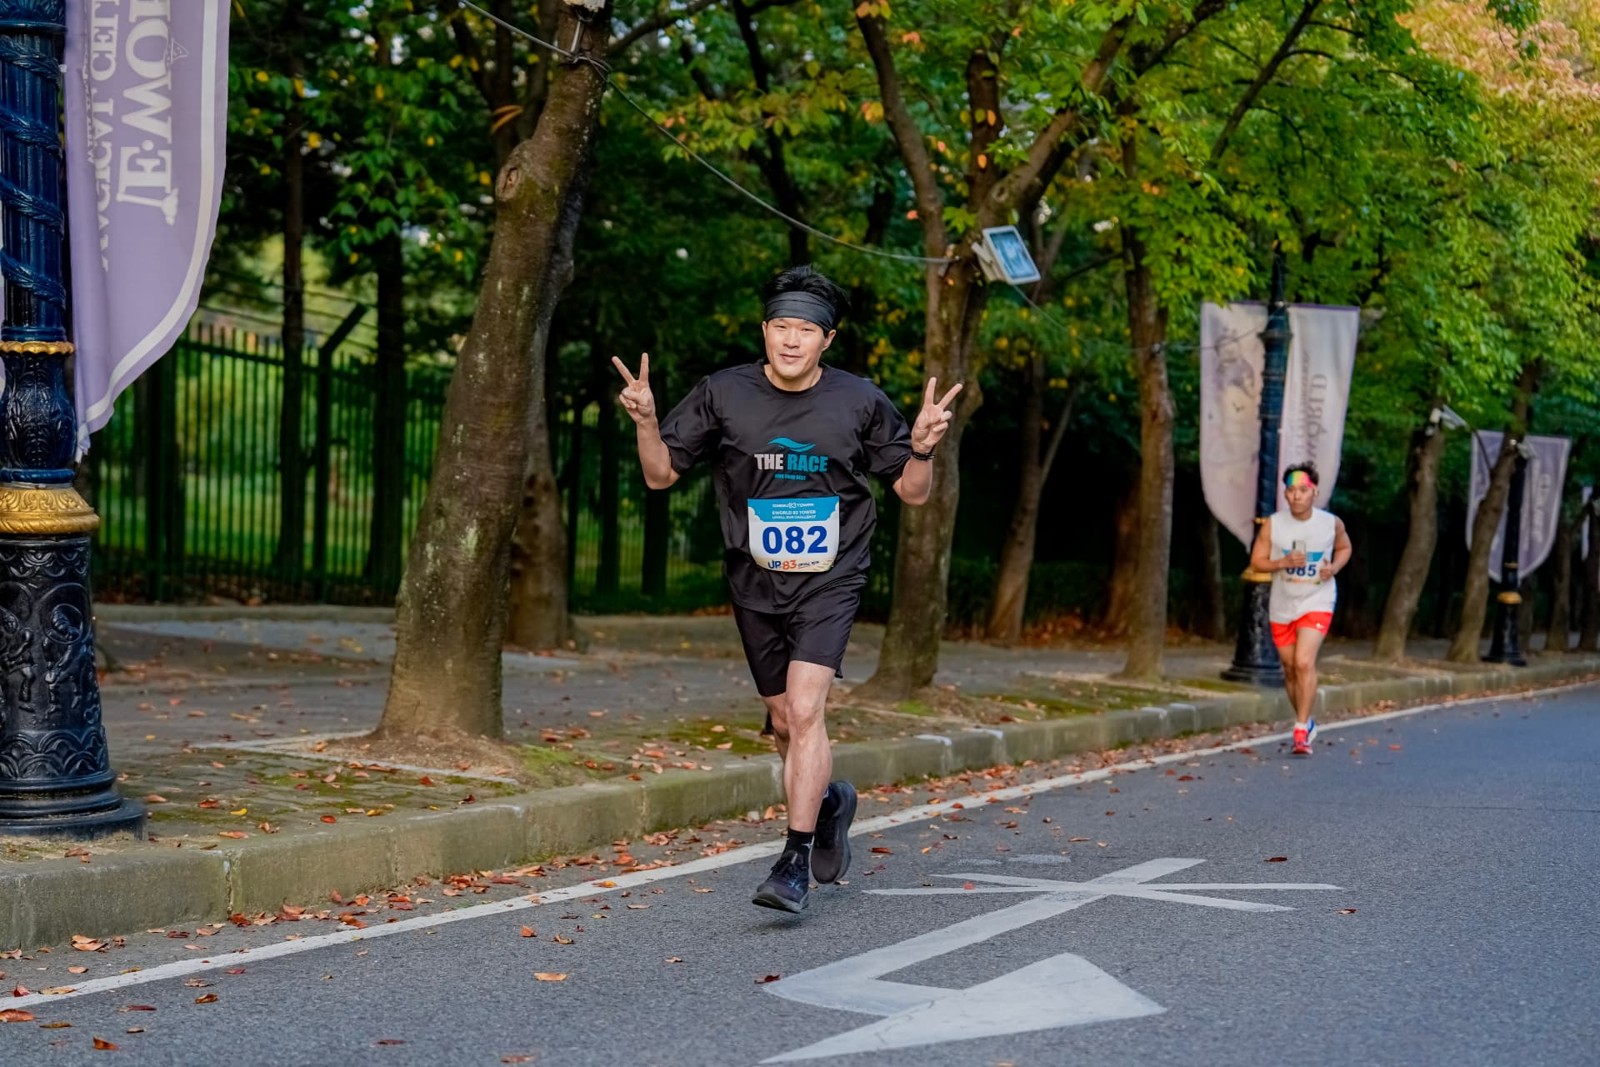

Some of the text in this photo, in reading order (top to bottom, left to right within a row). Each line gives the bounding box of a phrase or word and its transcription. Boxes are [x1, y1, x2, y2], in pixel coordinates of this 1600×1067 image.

[754, 453, 828, 472] THE RACE
[762, 525, 828, 555] 082
[783, 559, 797, 570] 83
